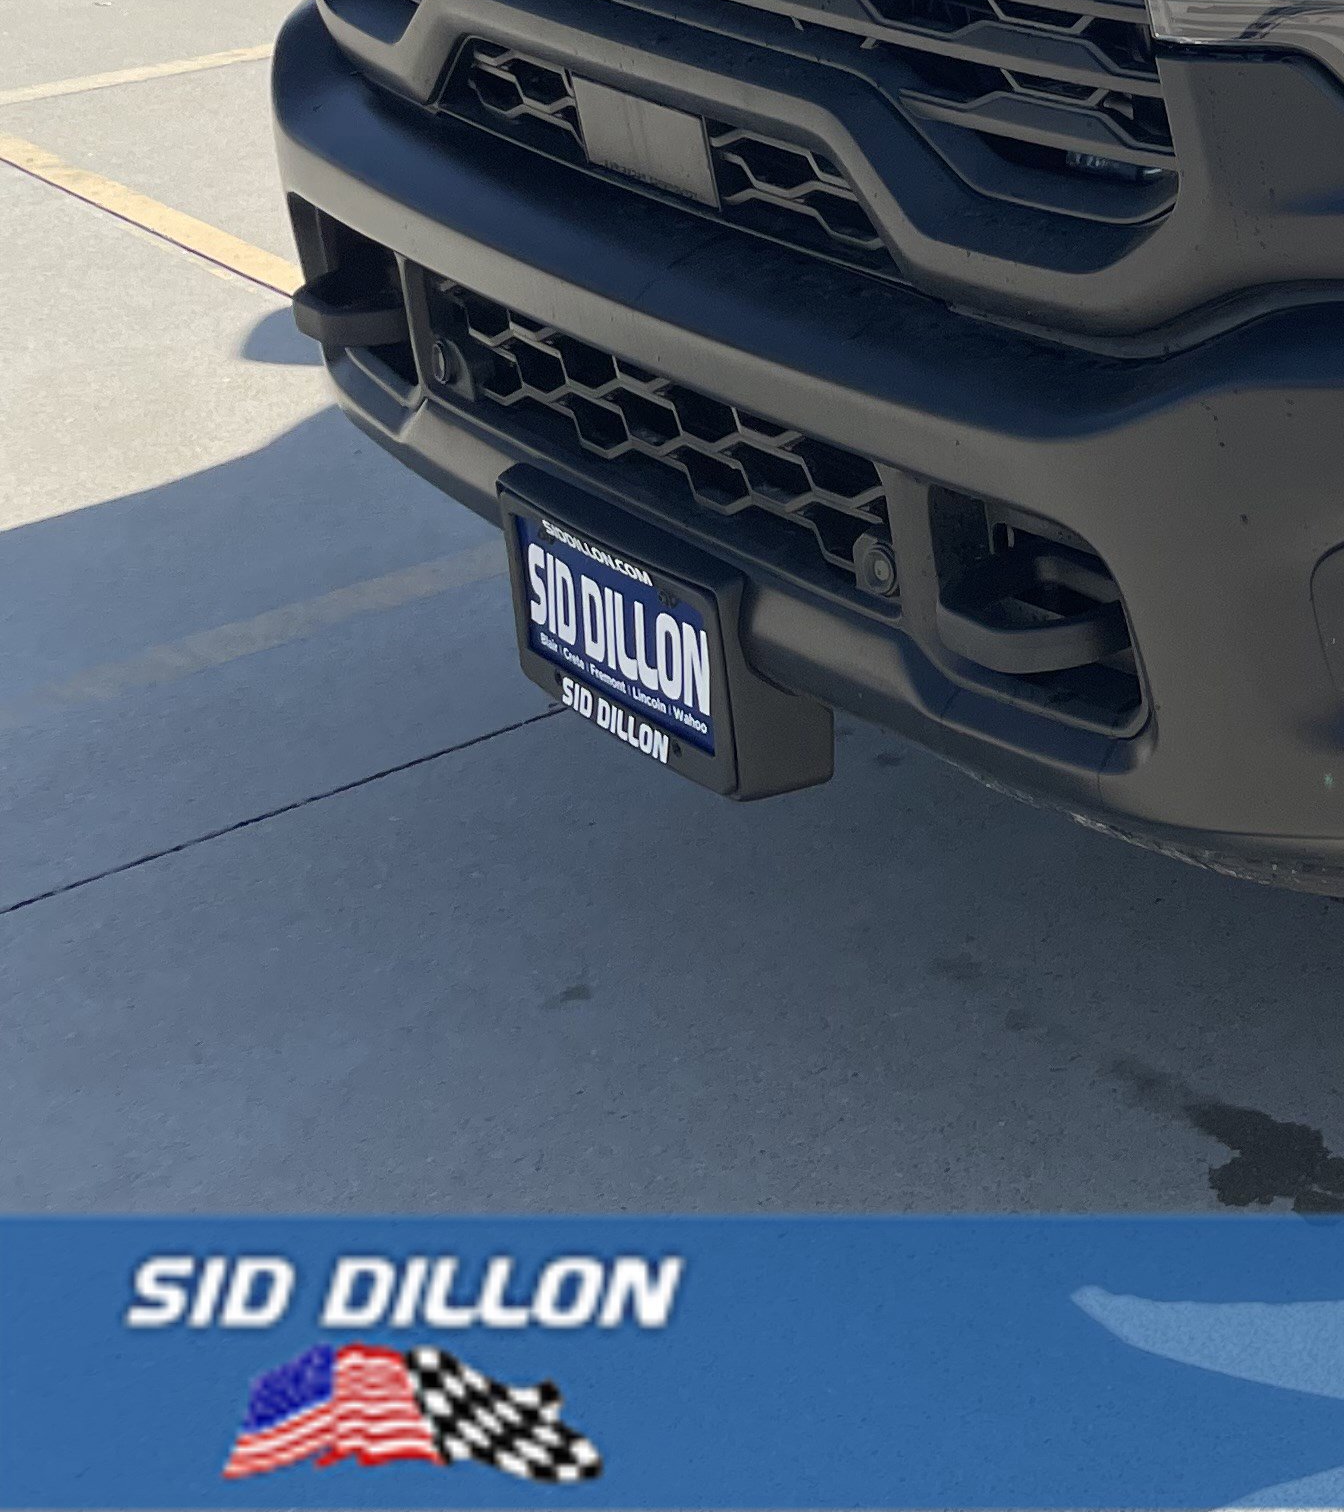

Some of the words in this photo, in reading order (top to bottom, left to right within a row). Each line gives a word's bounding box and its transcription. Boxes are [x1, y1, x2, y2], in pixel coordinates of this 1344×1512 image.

[541, 519, 654, 587] SIDDILLON.COM
[528, 542, 578, 647] SID
[580, 574, 710, 717] DILLON
[562, 676, 593, 720] SID
[596, 696, 669, 765] DILLON
[590, 662, 627, 694] Fremont
[632, 686, 667, 714] Lincoln
[672, 705, 708, 734] Wahoo
